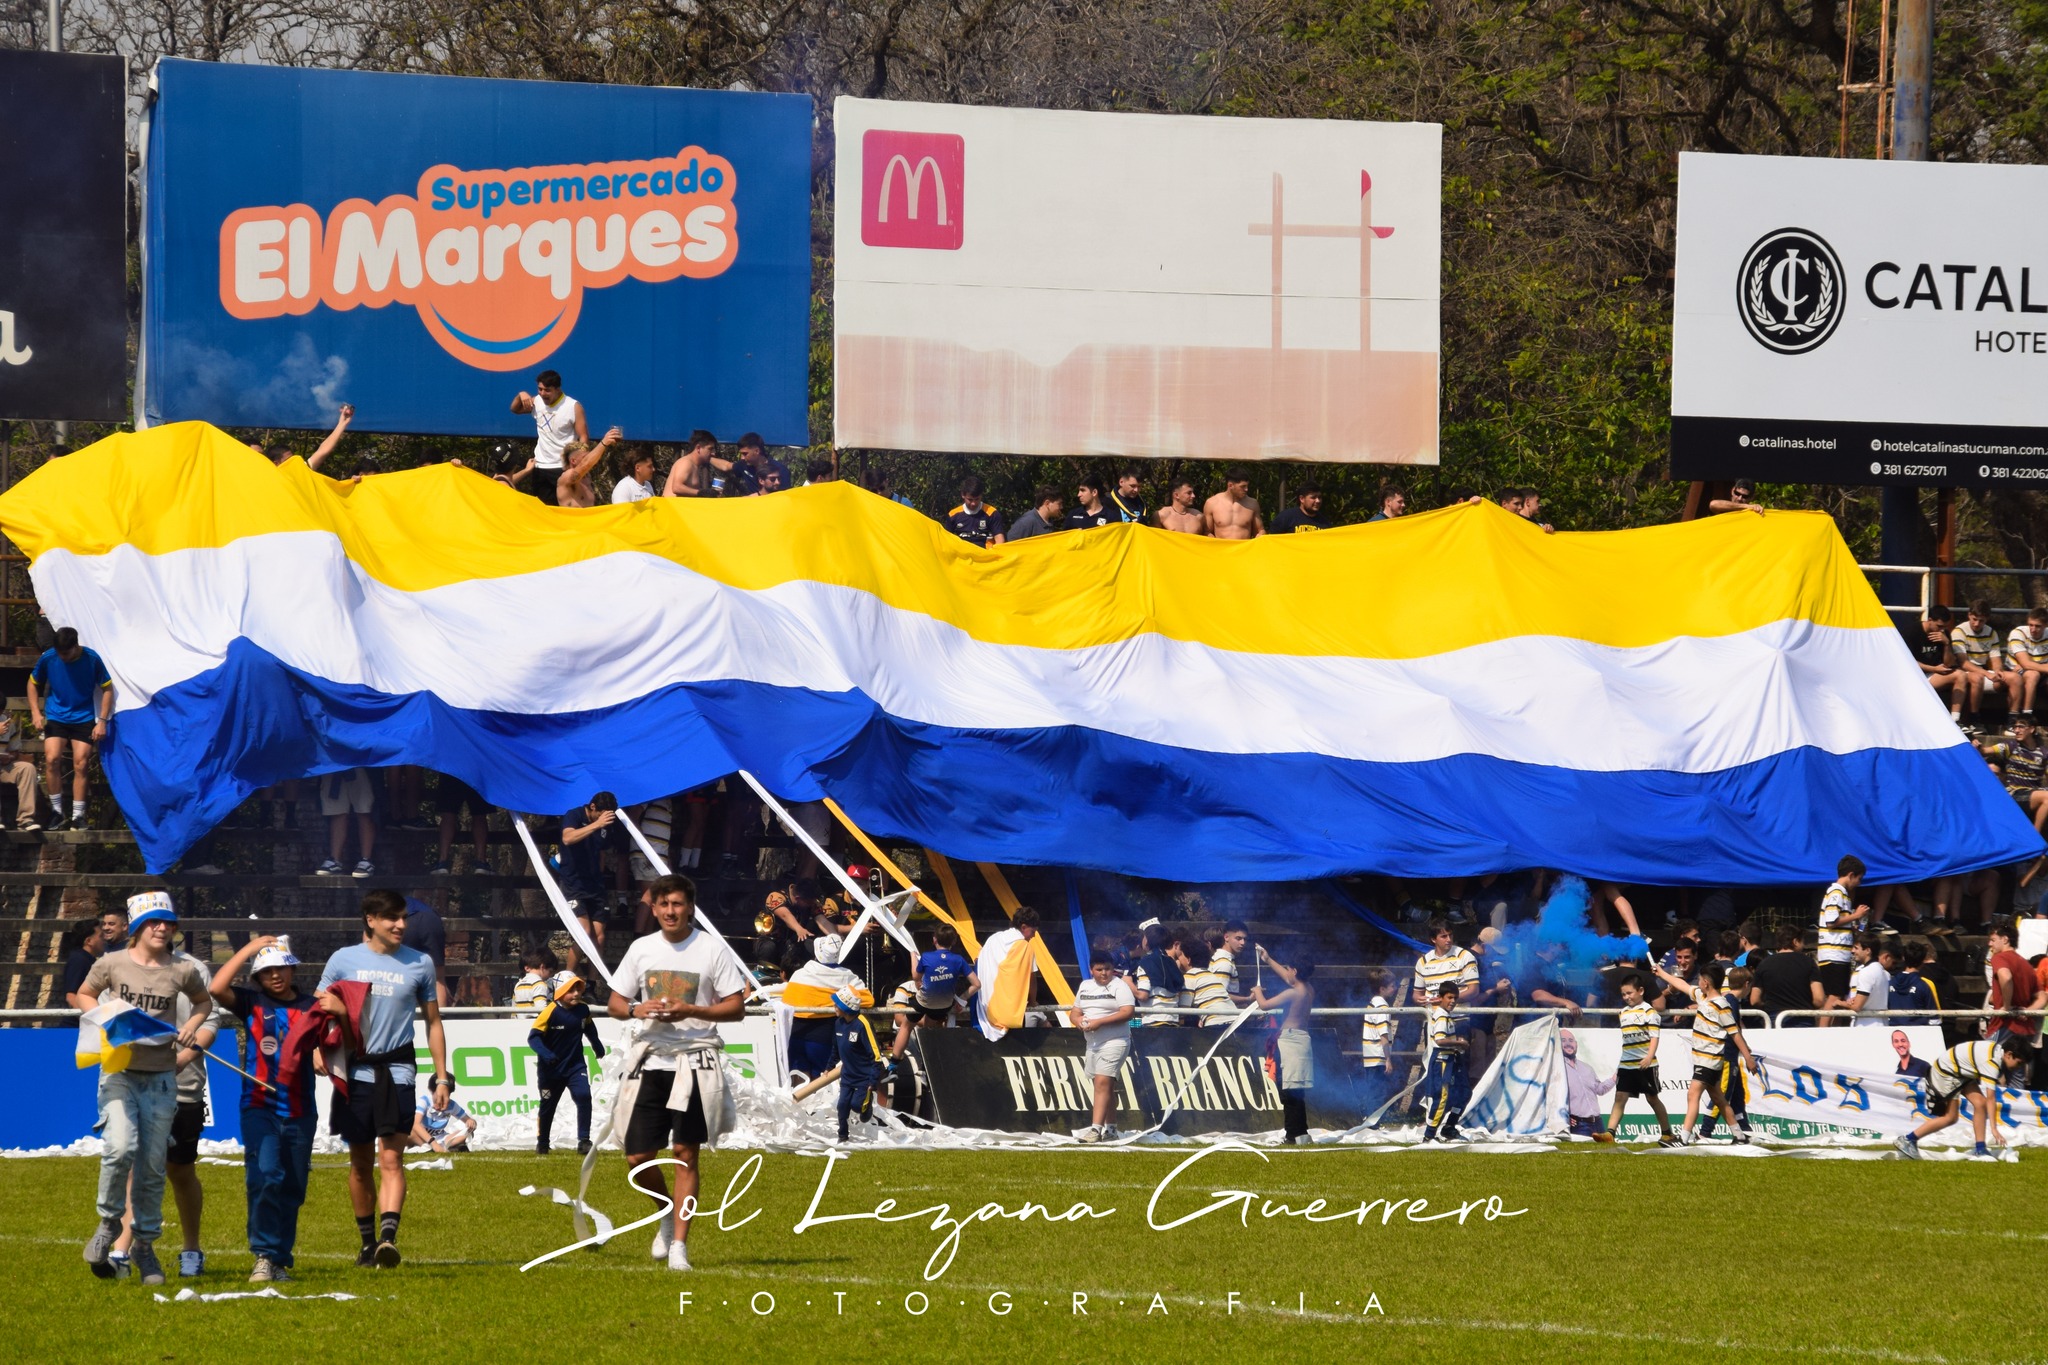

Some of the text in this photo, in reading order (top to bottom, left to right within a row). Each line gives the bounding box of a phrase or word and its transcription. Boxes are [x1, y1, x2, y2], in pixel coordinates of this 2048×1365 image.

[432, 158, 723, 218] Supermercado
[235, 205, 728, 303] El Marques
[1751, 436, 1837, 450] catalinas.hotel
[1883, 440, 2048, 456] hotelcatalinastucuman.com.
[1883, 463, 1947, 476] 381 6275071
[1992, 466, 2010, 478] 381
[356, 970, 404, 983] TROPICAL
[930, 973, 954, 982] PAMPA
[144, 986, 153, 994] THE
[119, 984, 172, 1013] BEATLES
[1001, 1055, 1284, 1111] FERNT BRANCA
[1625, 1124, 1648, 1136] SOLA
